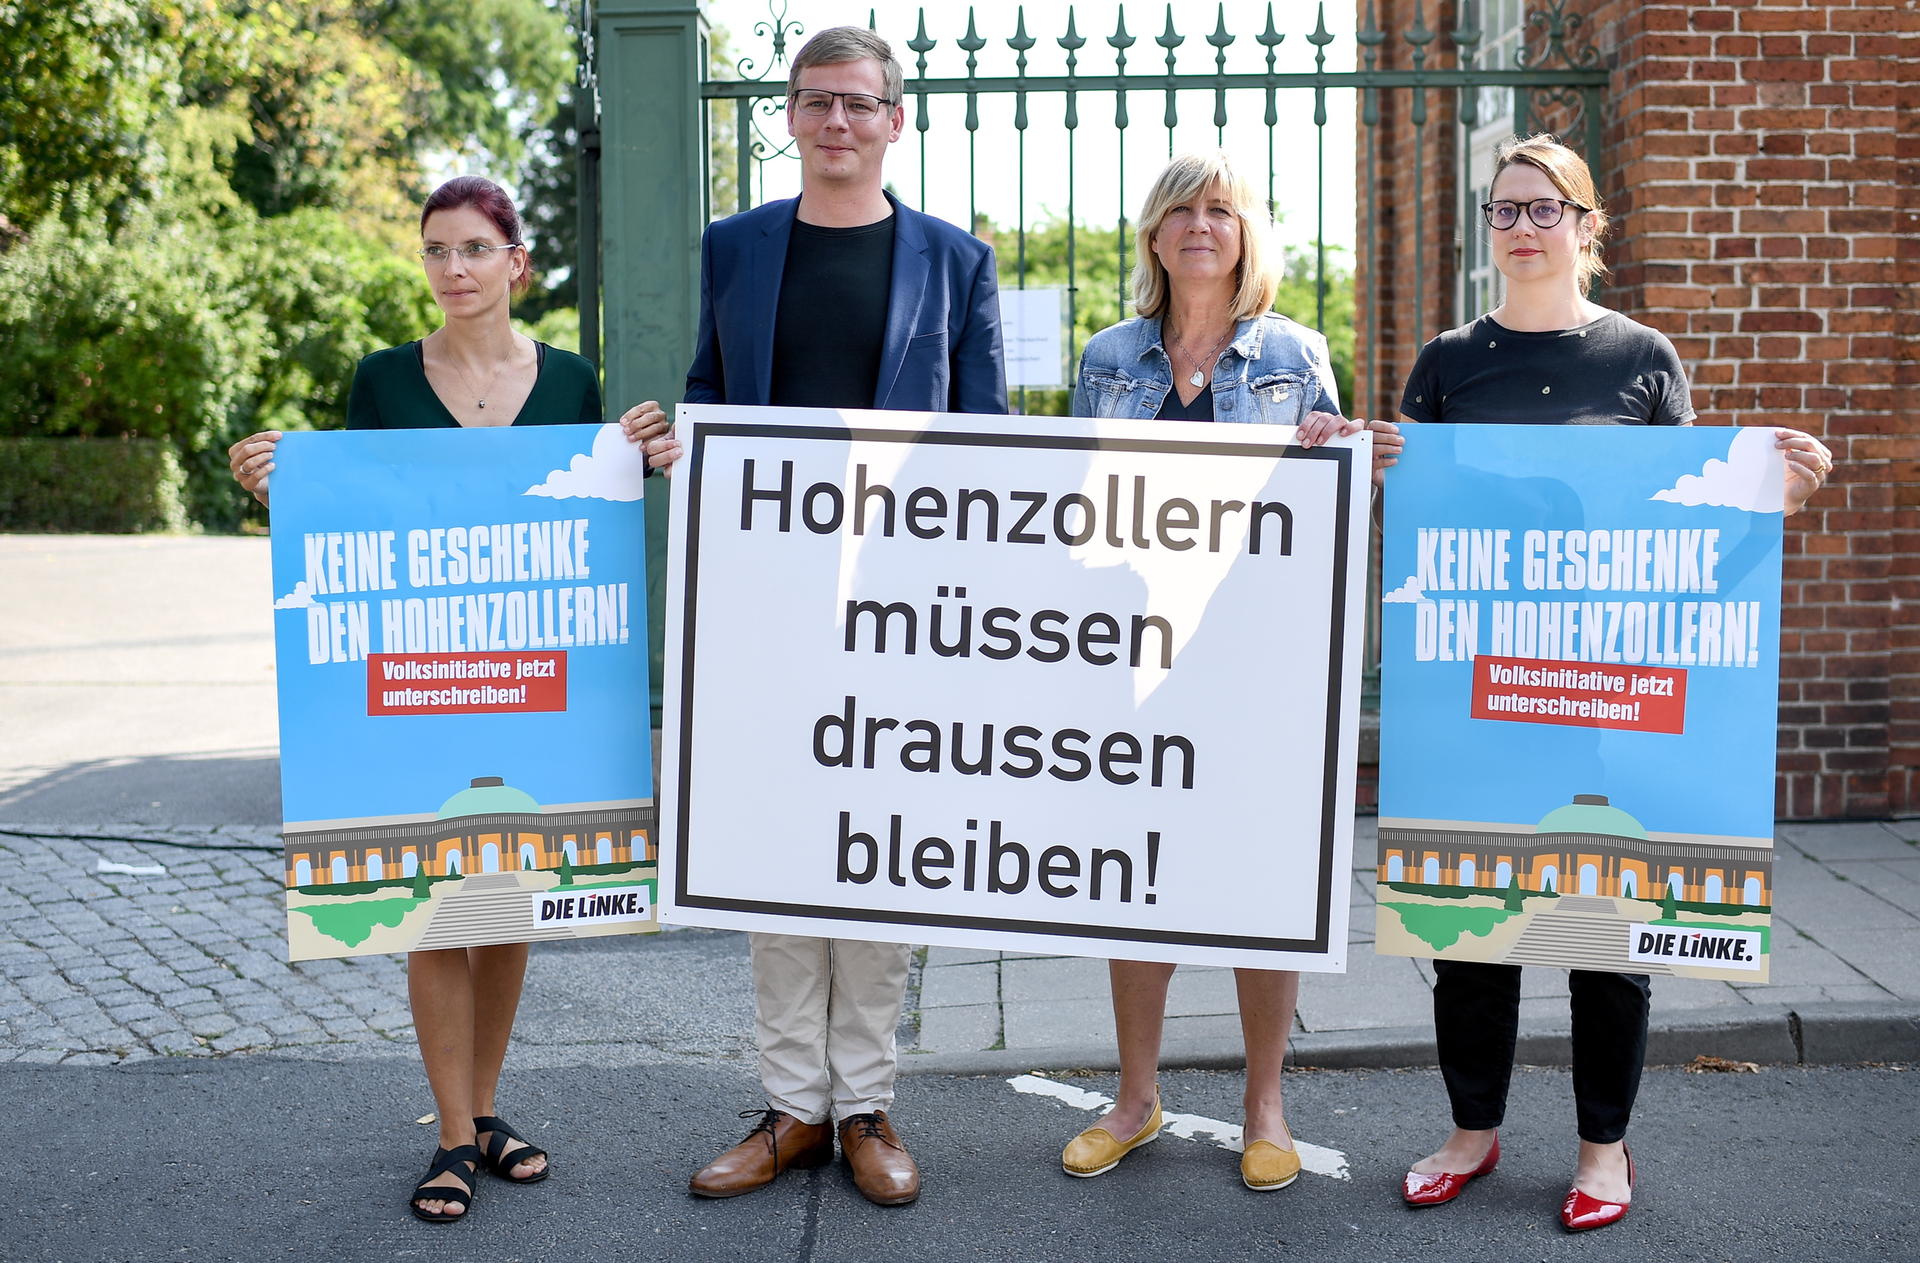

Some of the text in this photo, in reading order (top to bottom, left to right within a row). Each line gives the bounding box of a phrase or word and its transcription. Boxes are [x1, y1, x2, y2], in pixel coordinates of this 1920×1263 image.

[740, 458, 1294, 556] Hohenzollern
[304, 519, 590, 596] KEINE GESCHENKE
[1416, 527, 1720, 593] KEINE GESCHENKE
[307, 583, 629, 665] DEN HOHENZOLLERN!
[843, 585, 1173, 669] müssen
[1415, 599, 1761, 667] DEN HOHENZOLLERN!
[382, 657, 556, 682] Volksinitiative jetzt
[382, 684, 526, 707] unterschreiben!
[1489, 664, 1674, 697] Volksinitiative jetzt
[1487, 694, 1640, 721] unterschreiben!
[812, 695, 1196, 790] draussen
[836, 811, 1162, 905] bleiben!
[540, 898, 574, 921] DIE
[1637, 932, 1675, 956] DIE
